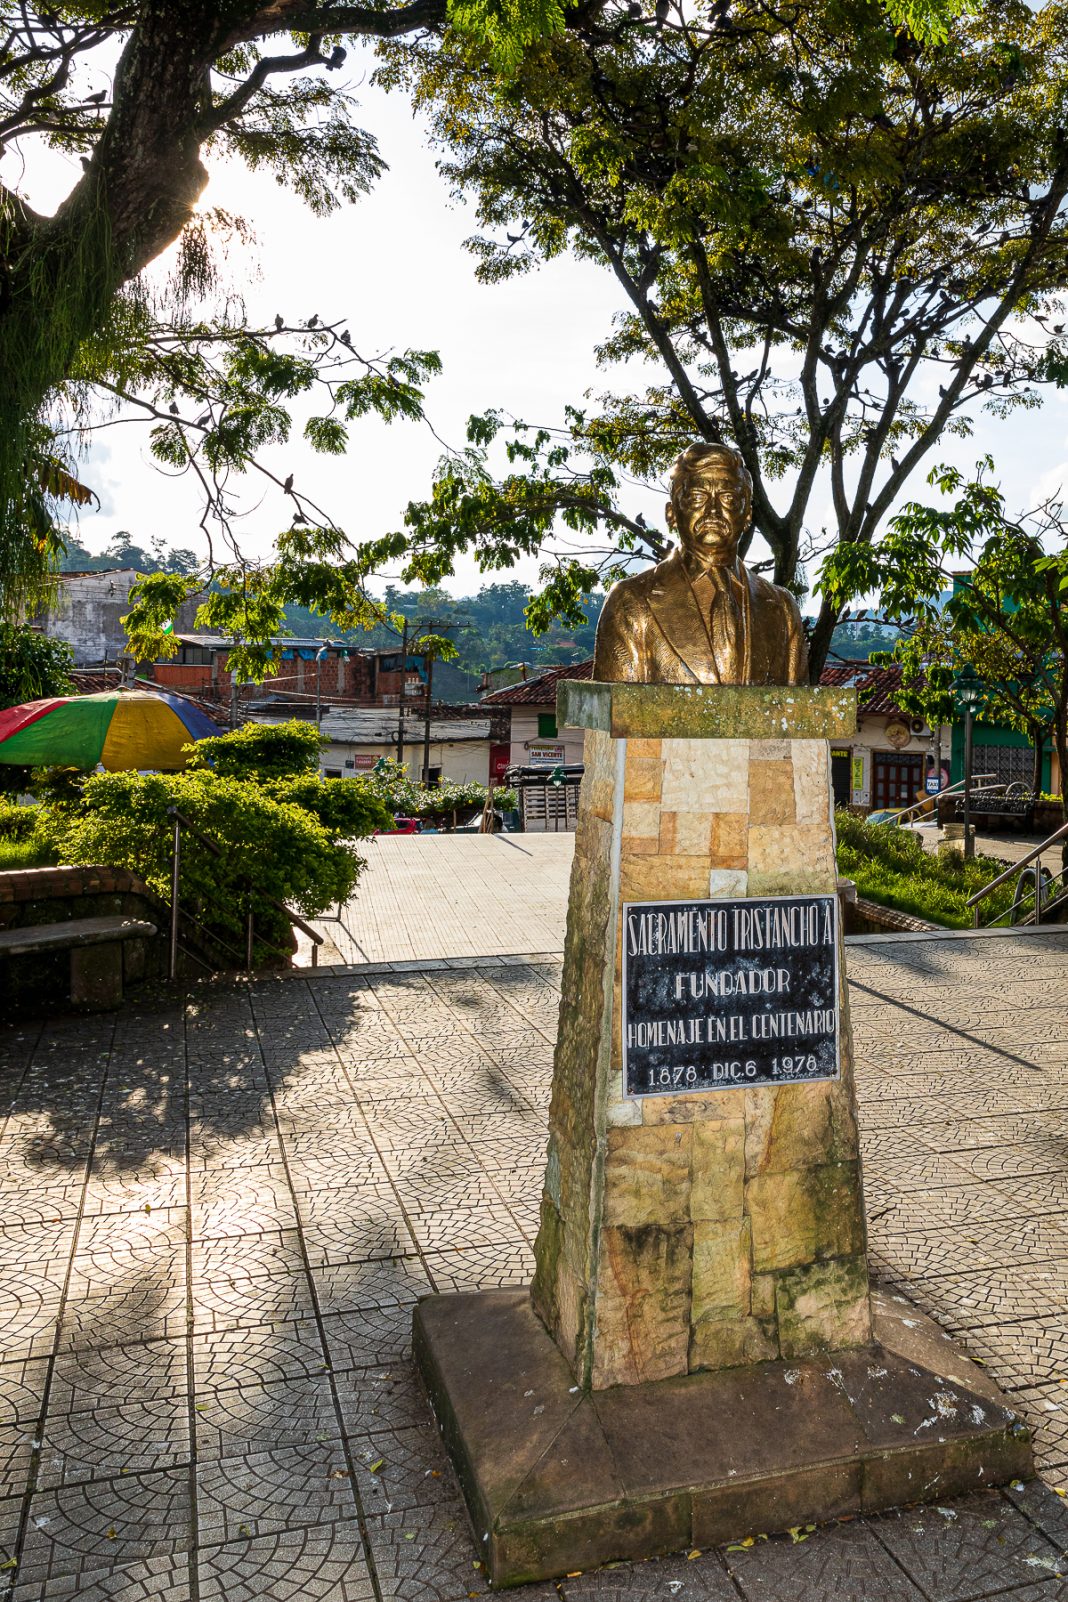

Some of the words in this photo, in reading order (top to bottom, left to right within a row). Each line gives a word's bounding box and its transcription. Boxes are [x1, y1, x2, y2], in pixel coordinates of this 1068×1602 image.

[628, 909, 728, 957] SACRAMENTO
[732, 905, 819, 951] TRISTANCHO
[675, 968, 791, 1000] FUNDADOR
[627, 1018, 704, 1049] HOMENAJE
[730, 1015, 748, 1041] EL
[752, 1009, 836, 1039] CENTENARIO
